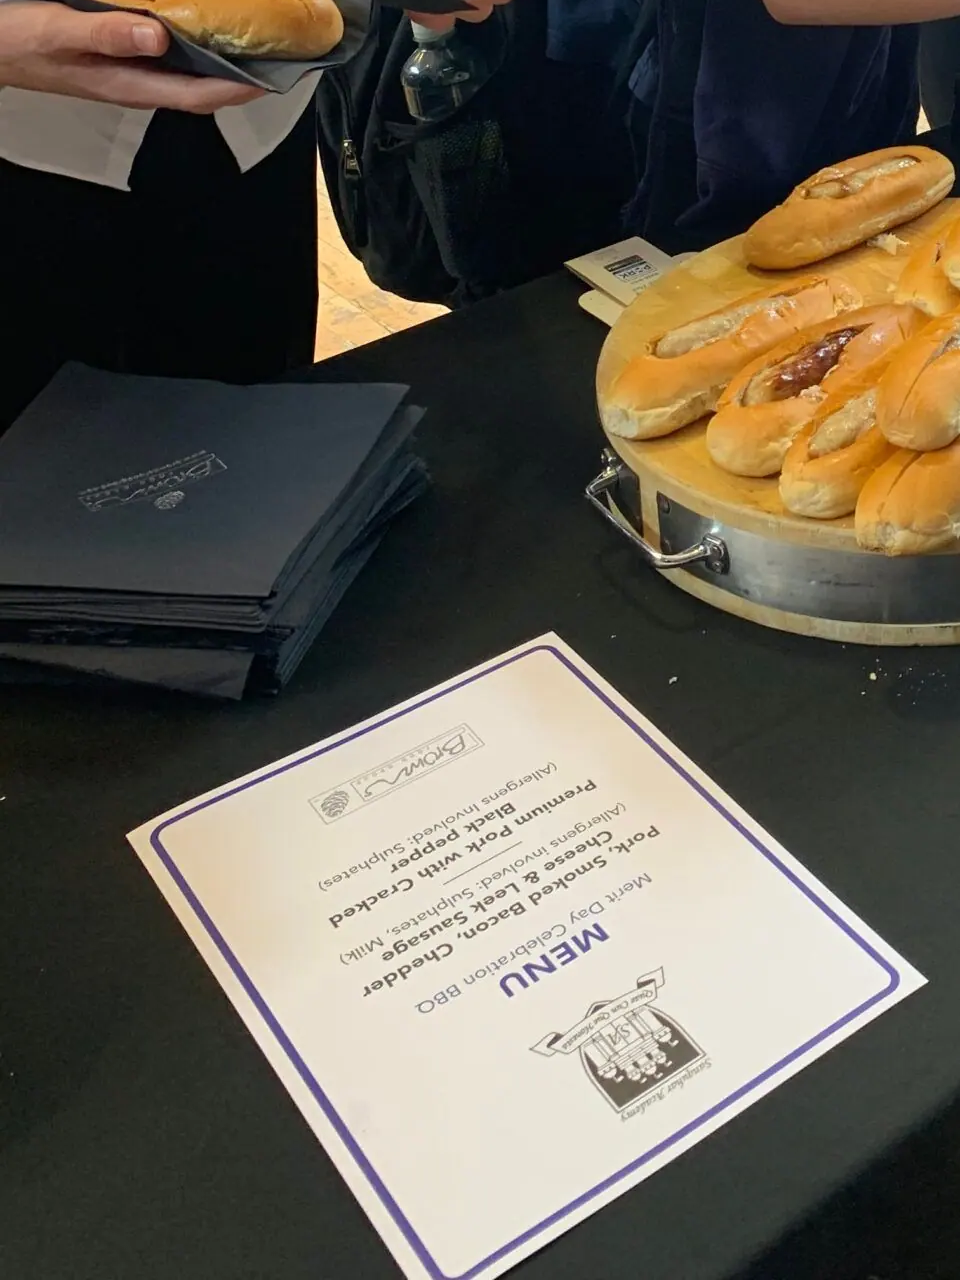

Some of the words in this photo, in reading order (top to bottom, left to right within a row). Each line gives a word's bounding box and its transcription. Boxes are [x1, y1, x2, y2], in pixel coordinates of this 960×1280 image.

[481, 762, 557, 806] (Allergens
[514, 779, 597, 826] Premium
[407, 803, 480, 845] Involved:
[463, 803, 516, 833] Black
[465, 824, 513, 854] Pork
[549, 802, 626, 848] (Allergens
[389, 828, 460, 874] pepper
[544, 830, 613, 871] Cheese
[608, 825, 660, 854] Pork,
[318, 843, 405, 893] Sulphates)
[417, 852, 462, 879] with
[475, 846, 550, 890] involved:
[522, 871, 540, 884] &
[528, 855, 607, 906] Smoked
[328, 878, 414, 929] Cracked
[469, 882, 521, 914] Leek
[604, 873, 653, 904] Merit
[386, 888, 475, 937] Sulphates,
[457, 901, 527, 939] Bacon,
[569, 901, 605, 925] Day
[339, 937, 384, 966] Milk)
[381, 911, 468, 962] Sausage
[462, 924, 567, 985] Celebration
[363, 944, 453, 998] Chedder
[499, 922, 610, 998] MENU
[414, 984, 462, 1013] BBQ
[620, 1090, 665, 1123] Academy
